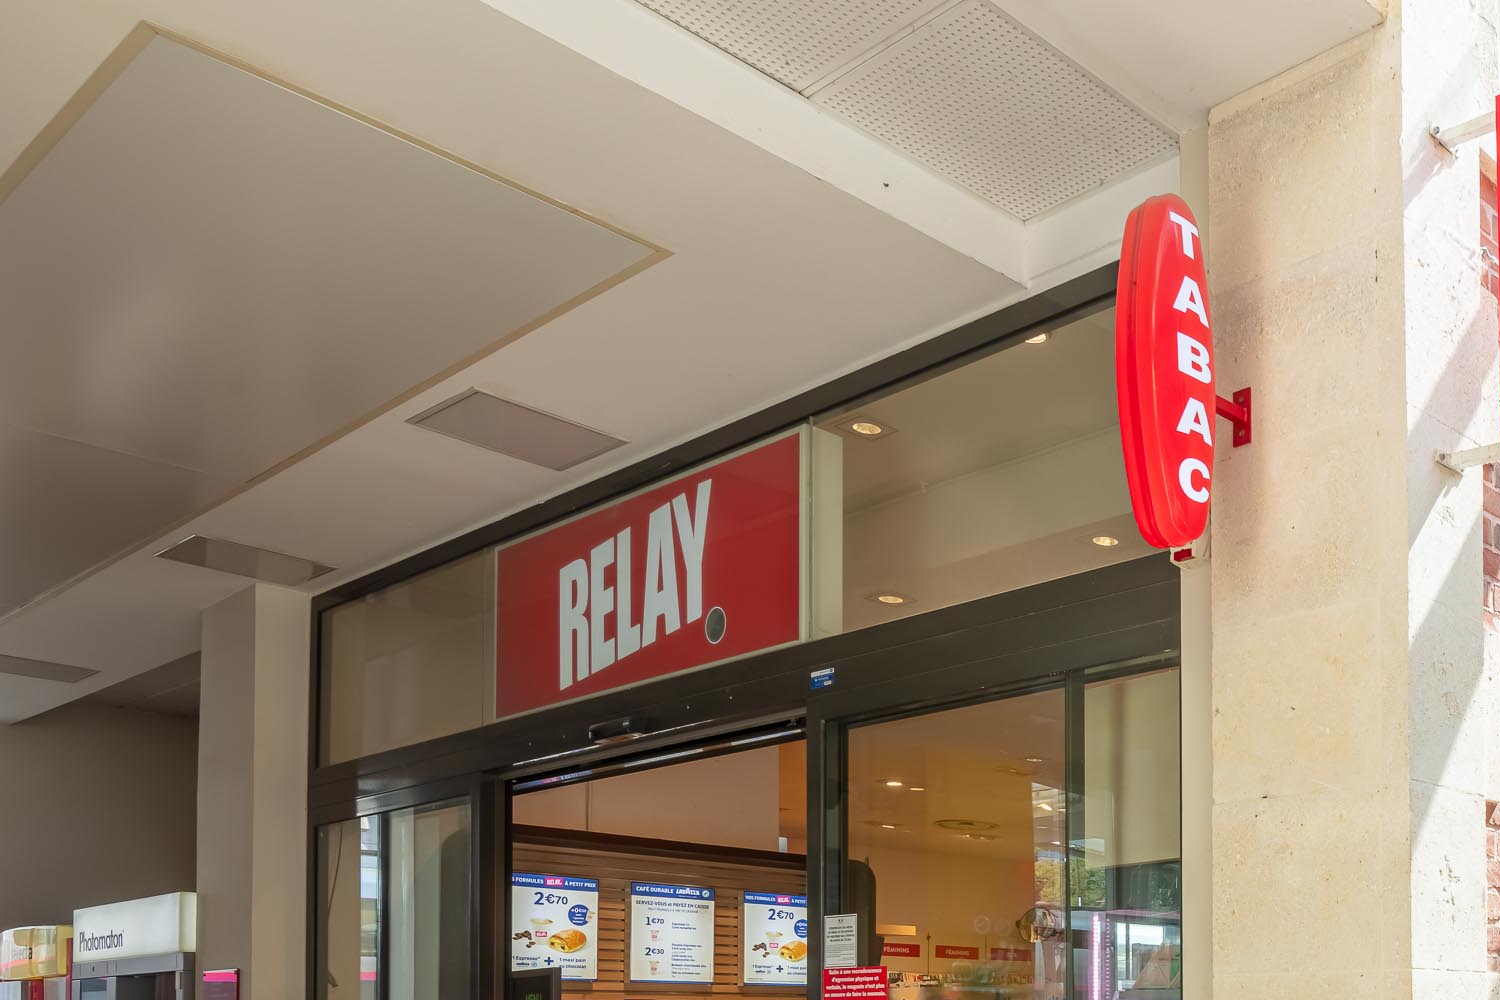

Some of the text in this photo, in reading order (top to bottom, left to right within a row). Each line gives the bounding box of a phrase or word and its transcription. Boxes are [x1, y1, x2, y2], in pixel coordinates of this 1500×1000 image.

[1169, 210, 1213, 504] TABAC
[559, 478, 713, 692] RELAY
[534, 891, 568, 905] 2€70
[768, 908, 794, 920] 2€70
[78, 931, 123, 952] Photomaton
